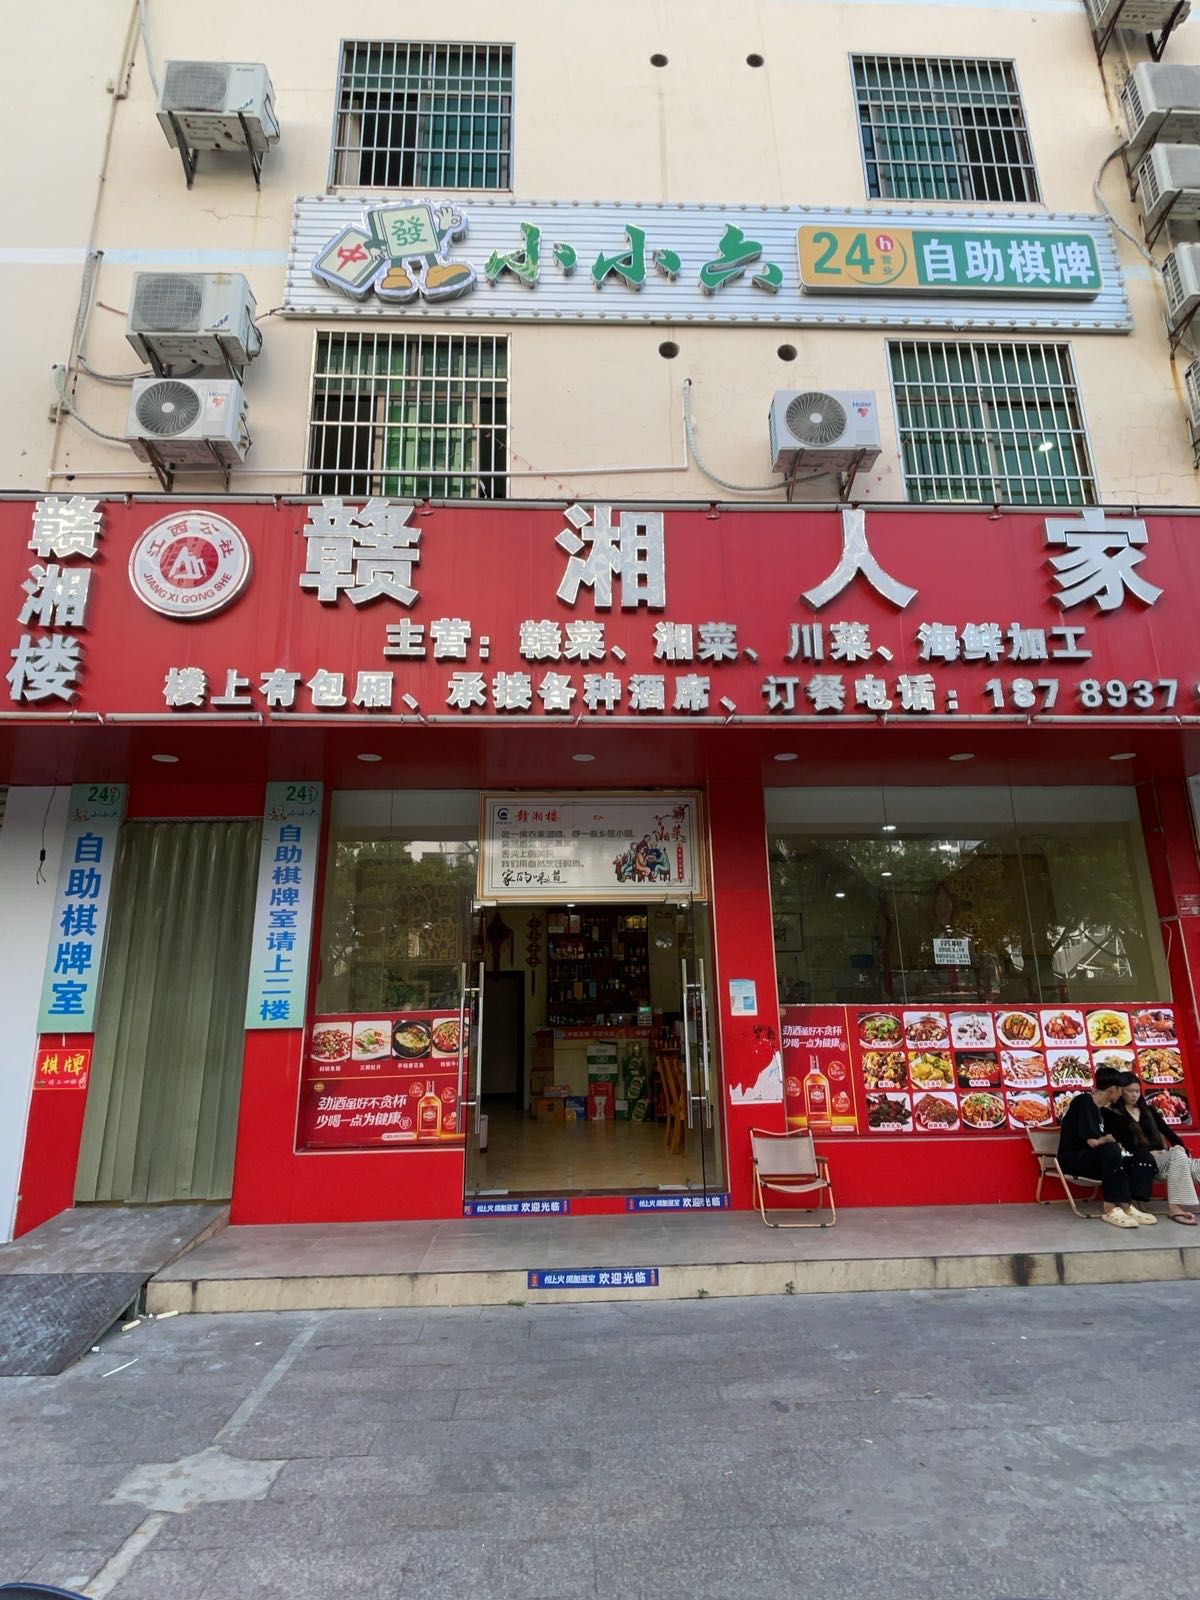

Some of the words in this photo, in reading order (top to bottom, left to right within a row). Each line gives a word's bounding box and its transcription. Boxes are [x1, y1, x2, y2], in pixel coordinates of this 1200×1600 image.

[391, 216, 428, 247] 發
[336, 241, 368, 272] 中
[922, 239, 1096, 285] 自助棋牌
[147, 520, 235, 559] 江西公社
[299, 498, 1164, 611] 赣湘人家
[6, 496, 103, 703] 赣湘楼
[144, 572, 168, 598] JIANG
[167, 592, 180, 603] XI
[181, 589, 215, 603] GONG
[213, 572, 232, 591] SHE
[985, 677, 1060, 709] 187
[1080, 677, 1179, 709] 8937
[501, 868, 568, 887] 家的味道
[48, 832, 103, 1015] 自助棋牌室
[259, 824, 302, 1021] 自助棋牌室请上二楼
[783, 1025, 842, 1037] 劲酒虽好不贪杯
[783, 1037, 841, 1049] 少喝一点为健康
[41, 1053, 85, 1076] 棋牌
[317, 1094, 407, 1111] 劲酒虽好不贪杯
[314, 1111, 402, 1129] 少喝一点为健康
[521, 1201, 560, 1213] 欢迎光临
[599, 1271, 646, 1286] 欢迎光临
